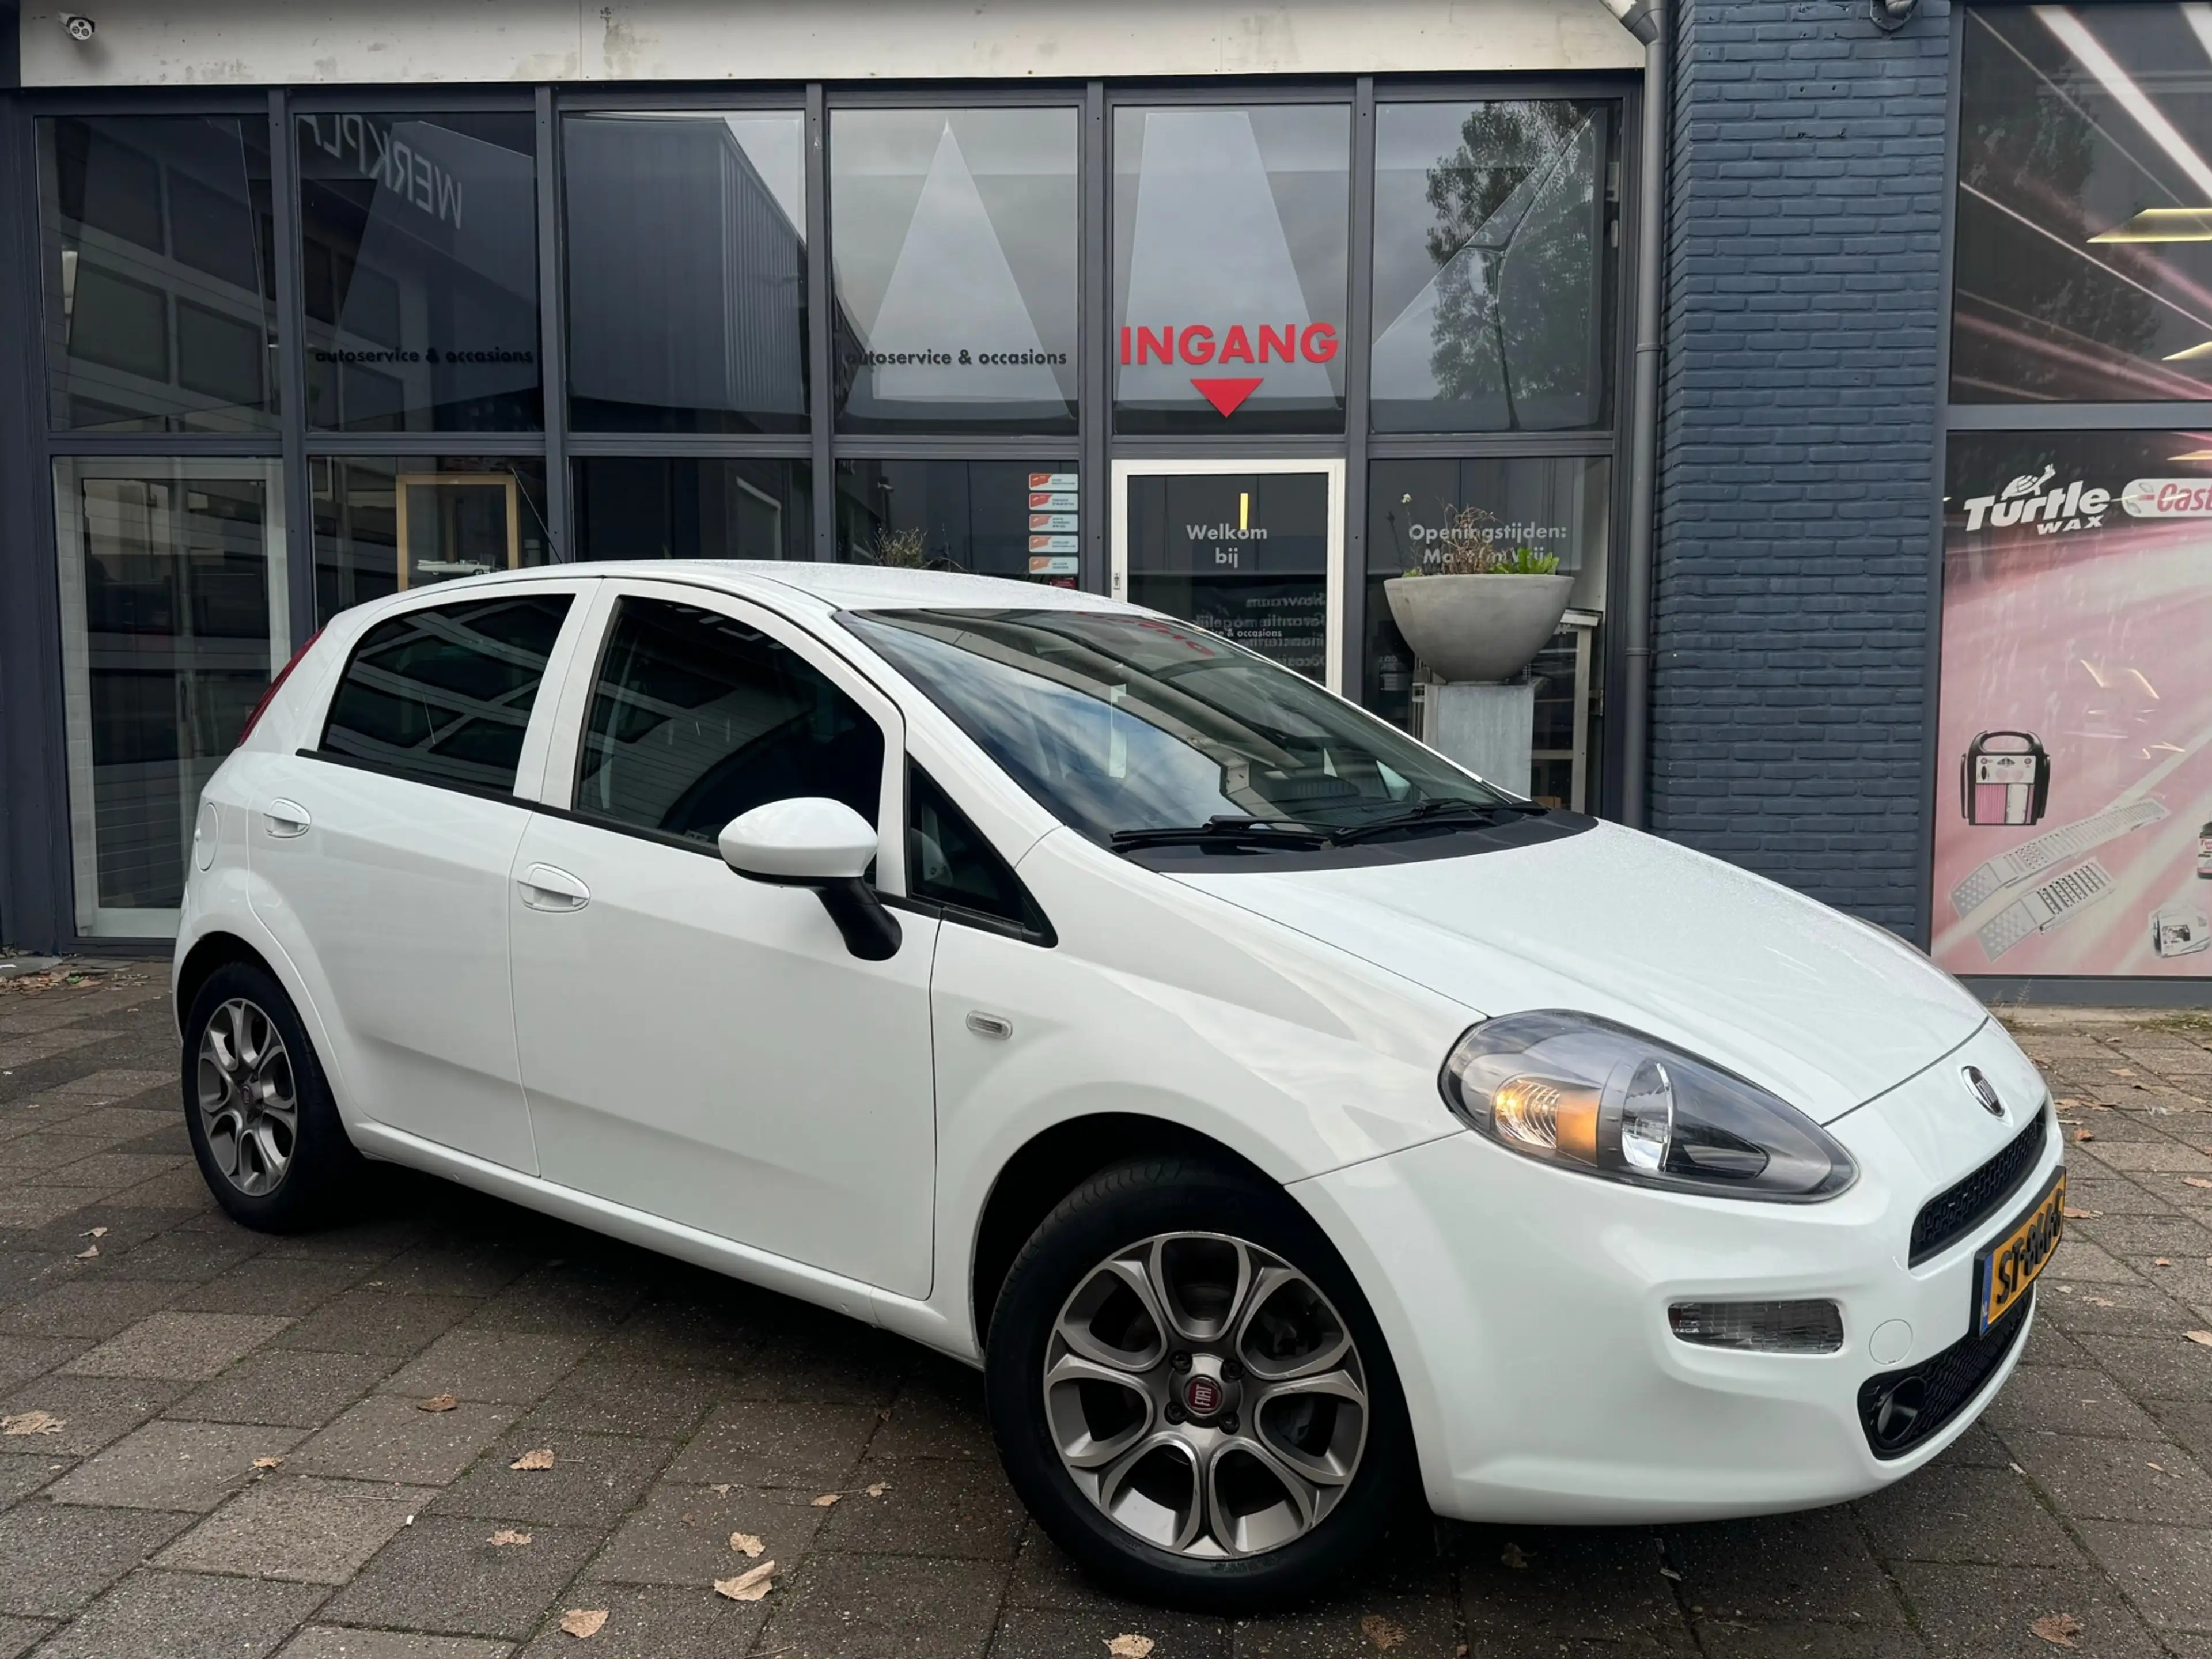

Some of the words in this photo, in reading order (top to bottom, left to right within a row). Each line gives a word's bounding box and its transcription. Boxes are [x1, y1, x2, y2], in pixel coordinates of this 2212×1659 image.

[1120, 323, 1339, 365] INGANG
[316, 347, 419, 363] autoservice
[426, 348, 439, 363] &
[446, 347, 533, 363] occasions
[847, 349, 952, 366] autoservice
[958, 349, 972, 365] &
[978, 349, 1067, 366] occasions
[1964, 480, 2111, 531] Turtle
[1186, 524, 1268, 540] Welkom
[1408, 521, 1567, 544] Openingstijden:
[2037, 515, 2103, 535] WAX
[1215, 547, 1238, 568] bij
[1423, 548, 1455, 564] Ma
[1237, 628, 1282, 638] occasions
[1195, 1384, 1212, 1406] FIAT
